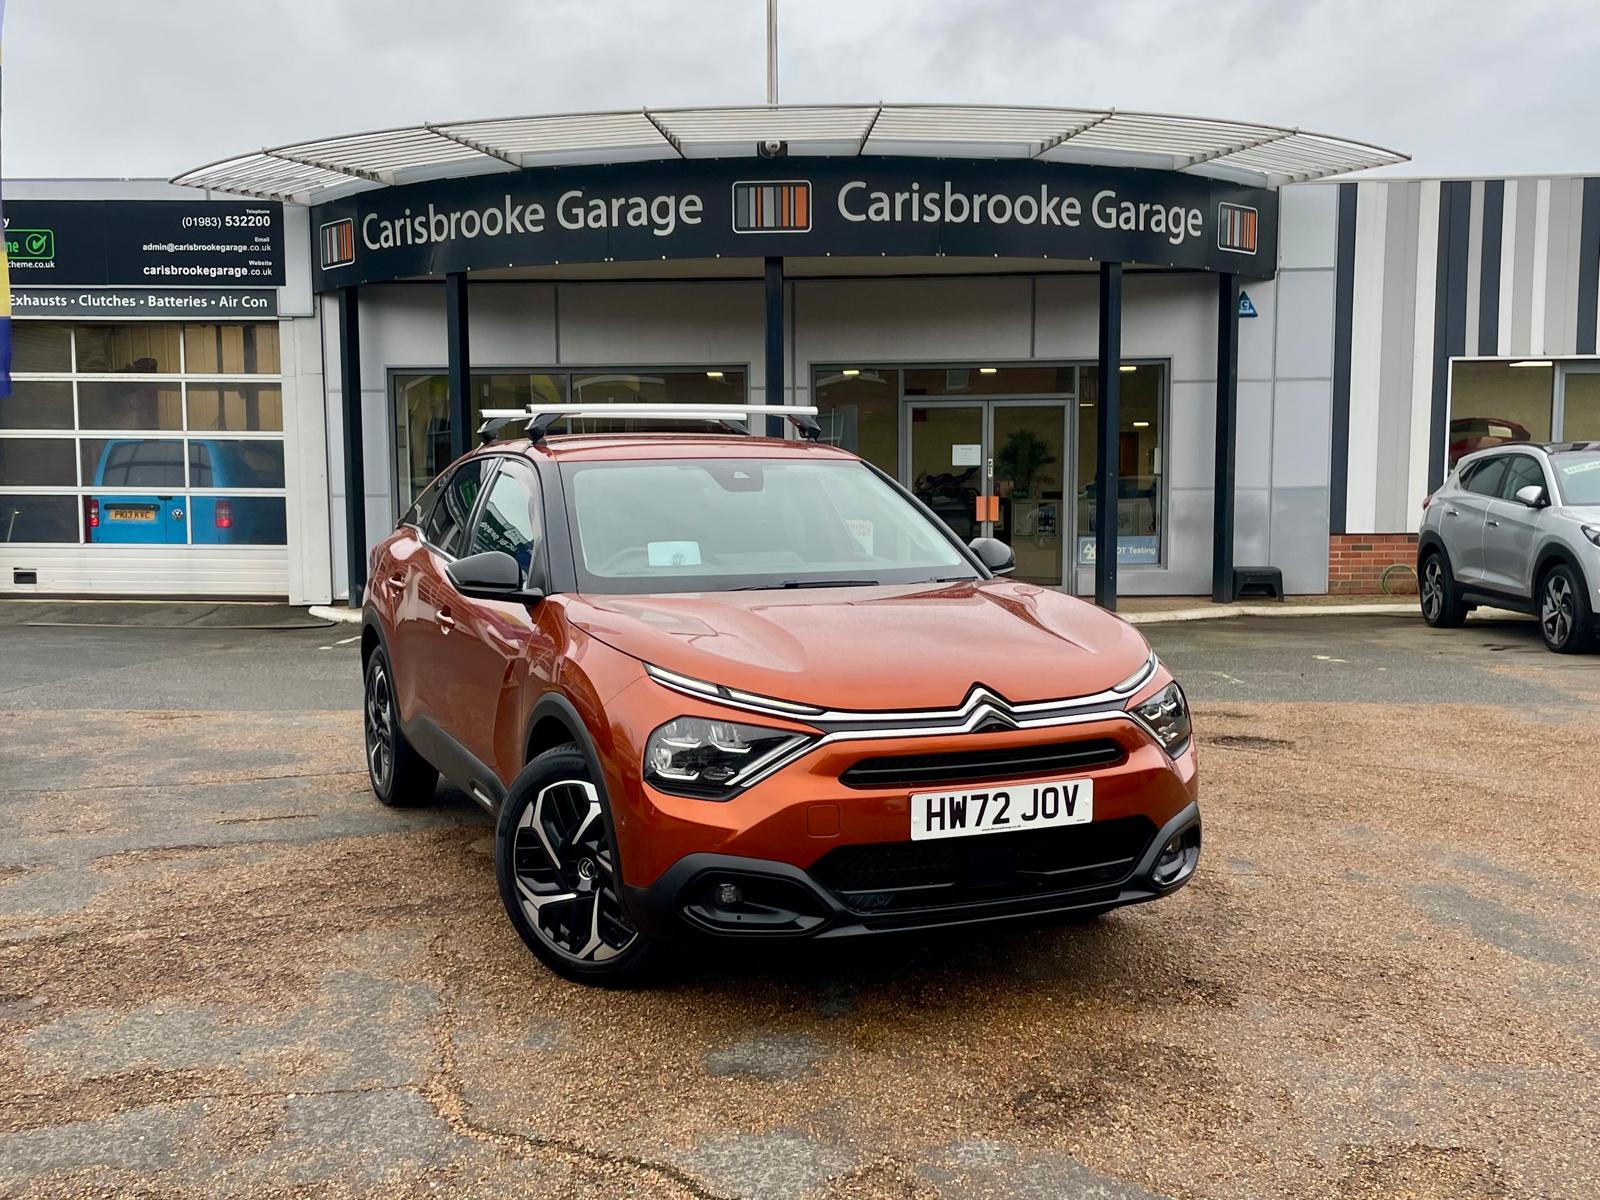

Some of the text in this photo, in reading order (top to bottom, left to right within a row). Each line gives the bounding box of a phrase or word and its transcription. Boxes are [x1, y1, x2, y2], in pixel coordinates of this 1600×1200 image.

[837, 181, 1203, 245] Carisbrooke Garage
[182, 216, 271, 229] (01983) 532200
[362, 190, 704, 250] Carisbrooke Garage
[143, 243, 271, 253] admin@carisbrookegarage.co.uk
[143, 265, 273, 277] carisbrookegarage.co.uk
[10, 294, 268, 308] Exhausts Clutches Batteries Air Con
[134, 511, 150, 519] KVC
[1129, 546, 1156, 555] Testing
[926, 784, 1079, 832] HW72 JOV
